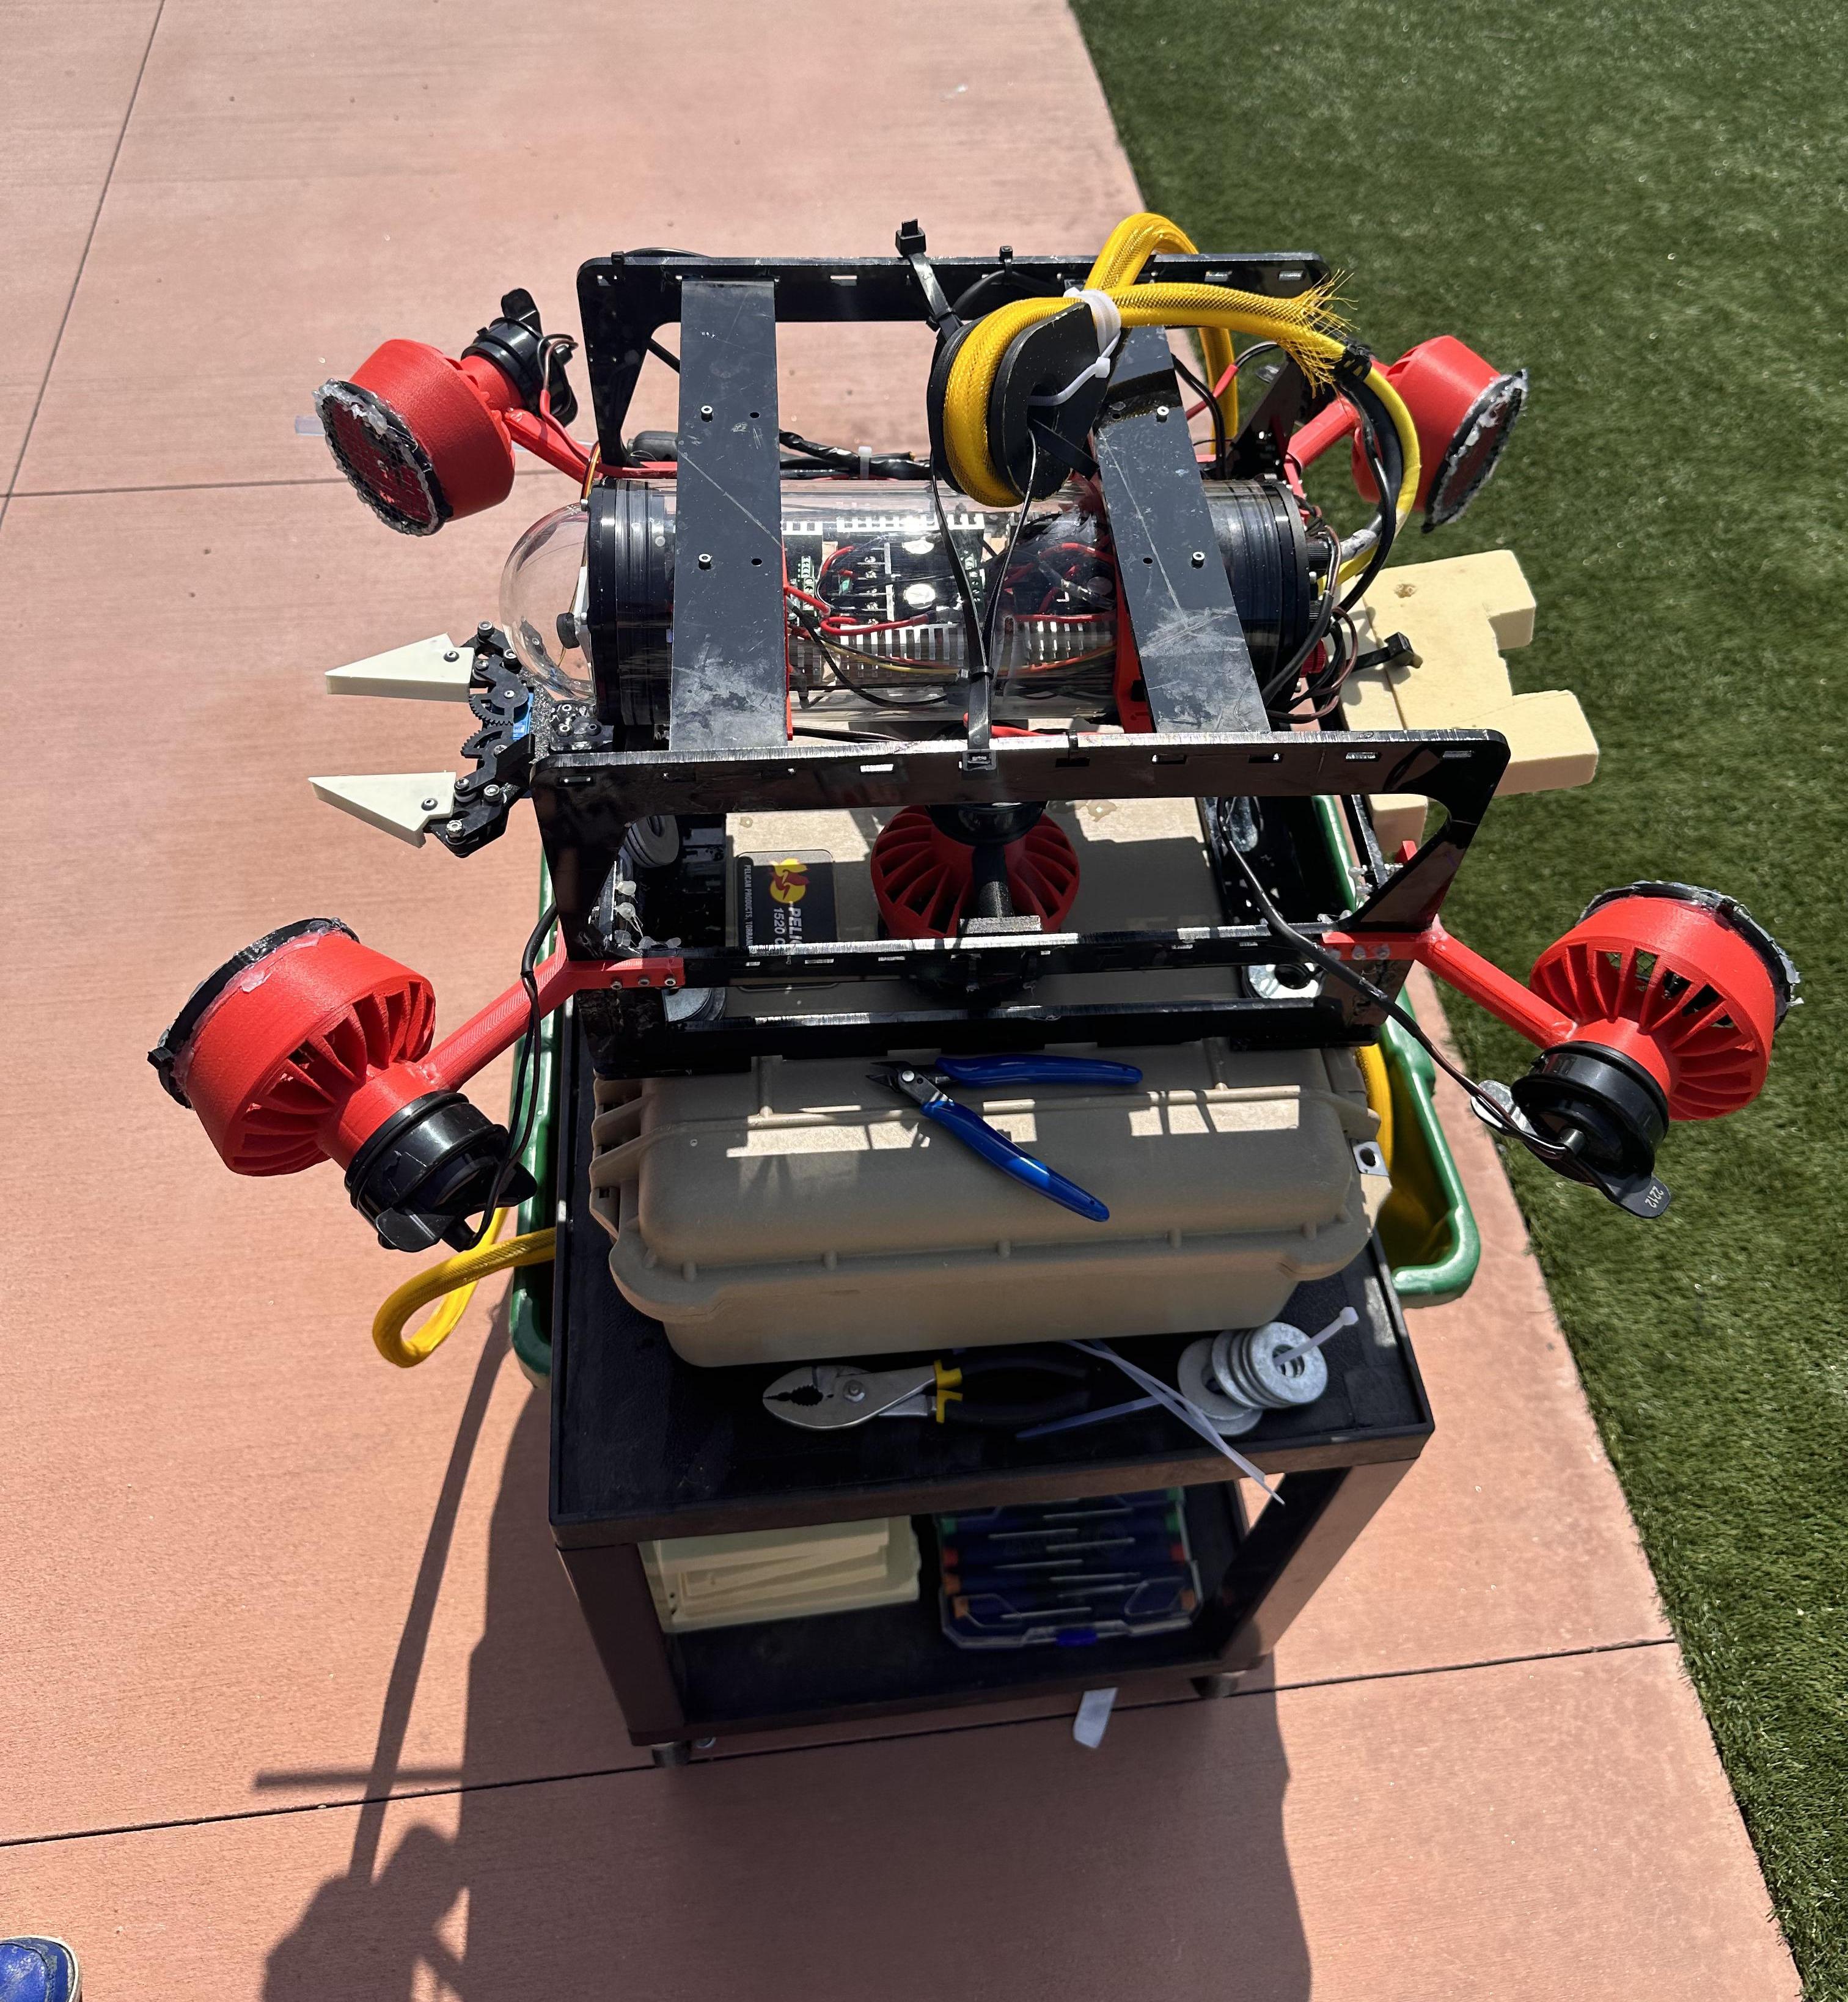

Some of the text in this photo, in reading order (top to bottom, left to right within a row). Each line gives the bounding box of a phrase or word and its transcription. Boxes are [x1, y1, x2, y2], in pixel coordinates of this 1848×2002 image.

[744, 864, 752, 888] PELICAN
[744, 888, 753, 920] PRODUCTS,
[773, 908, 785, 934] 1520
[1645, 1186, 1664, 1208] 2212
